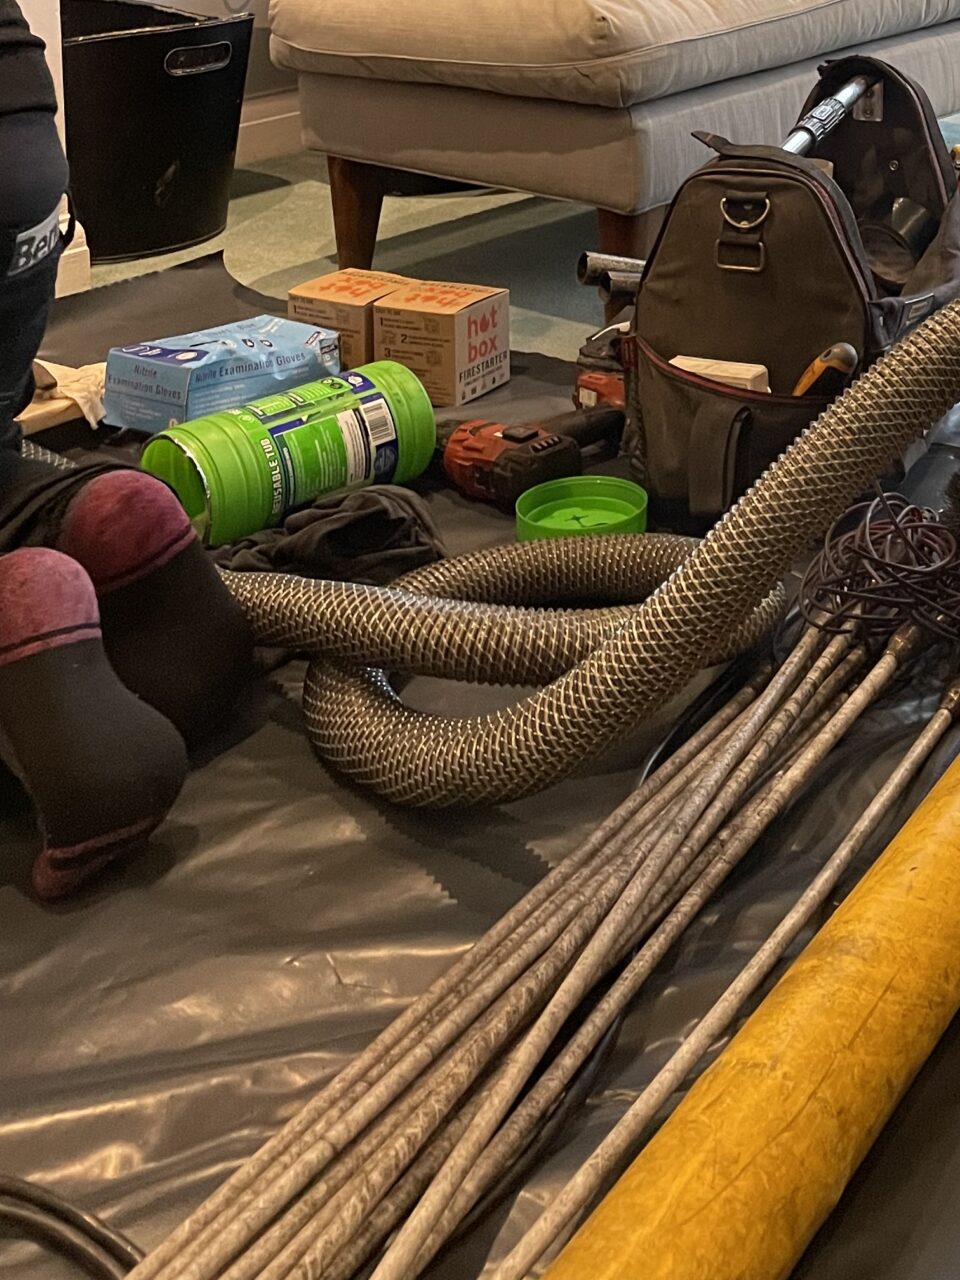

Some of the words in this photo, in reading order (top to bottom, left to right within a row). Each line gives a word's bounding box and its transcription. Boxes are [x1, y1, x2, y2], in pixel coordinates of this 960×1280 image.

[400, 333, 408, 344] 2
[467, 336, 498, 364] box
[384, 347, 391, 358] 3
[134, 363, 158, 380] Nitrile
[219, 358, 274, 379] Examination
[276, 351, 307, 367] Gloves
[459, 350, 508, 384] FIRESTARTER
[108, 374, 154, 394] Examination
[155, 384, 182, 401] Gloves
[260, 438, 276, 458] TUB
